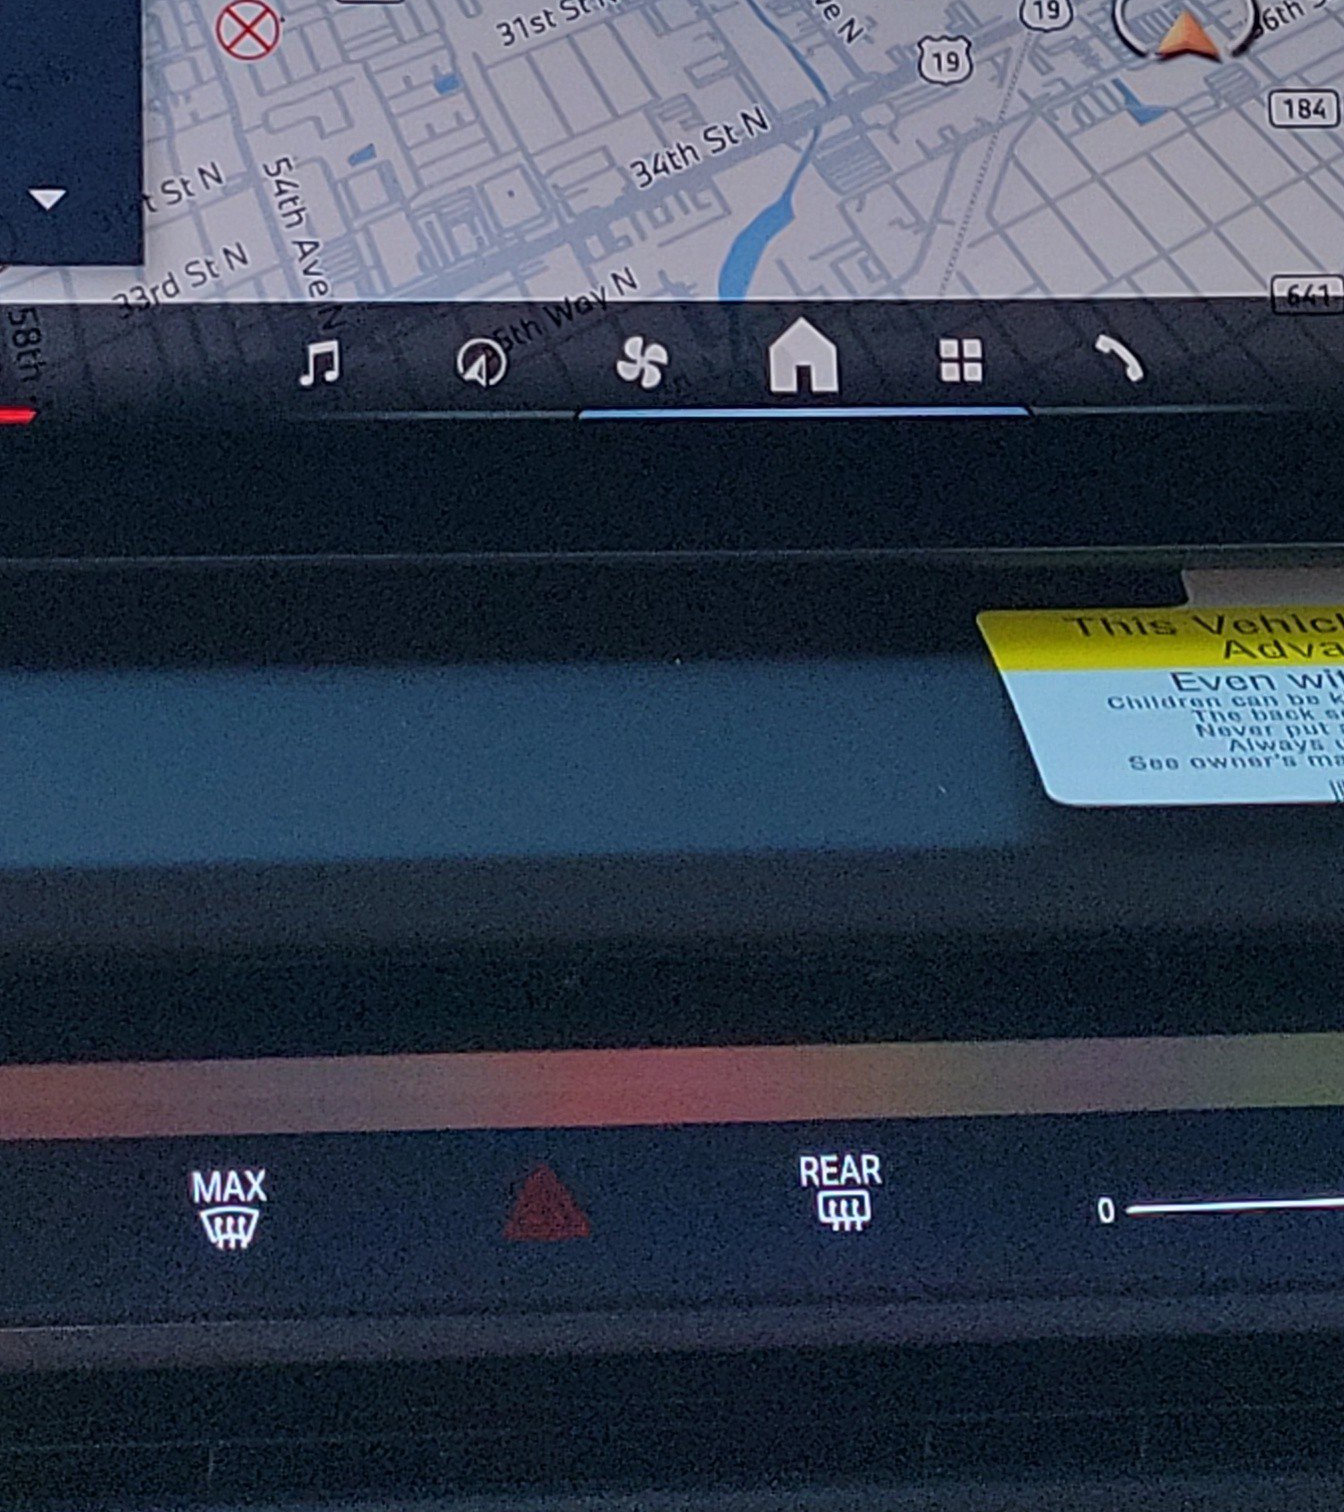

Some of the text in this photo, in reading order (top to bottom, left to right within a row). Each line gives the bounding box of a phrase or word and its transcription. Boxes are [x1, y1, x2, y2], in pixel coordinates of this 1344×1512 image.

[1033, 0, 1060, 20] 19
[495, 15, 558, 48] 31st
[837, 16, 865, 45] N
[932, 51, 958, 72] 19
[1283, 98, 1326, 120] 184
[629, 105, 770, 190] 34th St N
[1064, 615, 1177, 637] This
[1170, 671, 1278, 693] Even
[1107, 693, 1223, 711] Children
[1231, 693, 1280, 708] can
[1287, 693, 1321, 707] be
[799, 1155, 884, 1186] REAR
[190, 1171, 268, 1203] MAX
